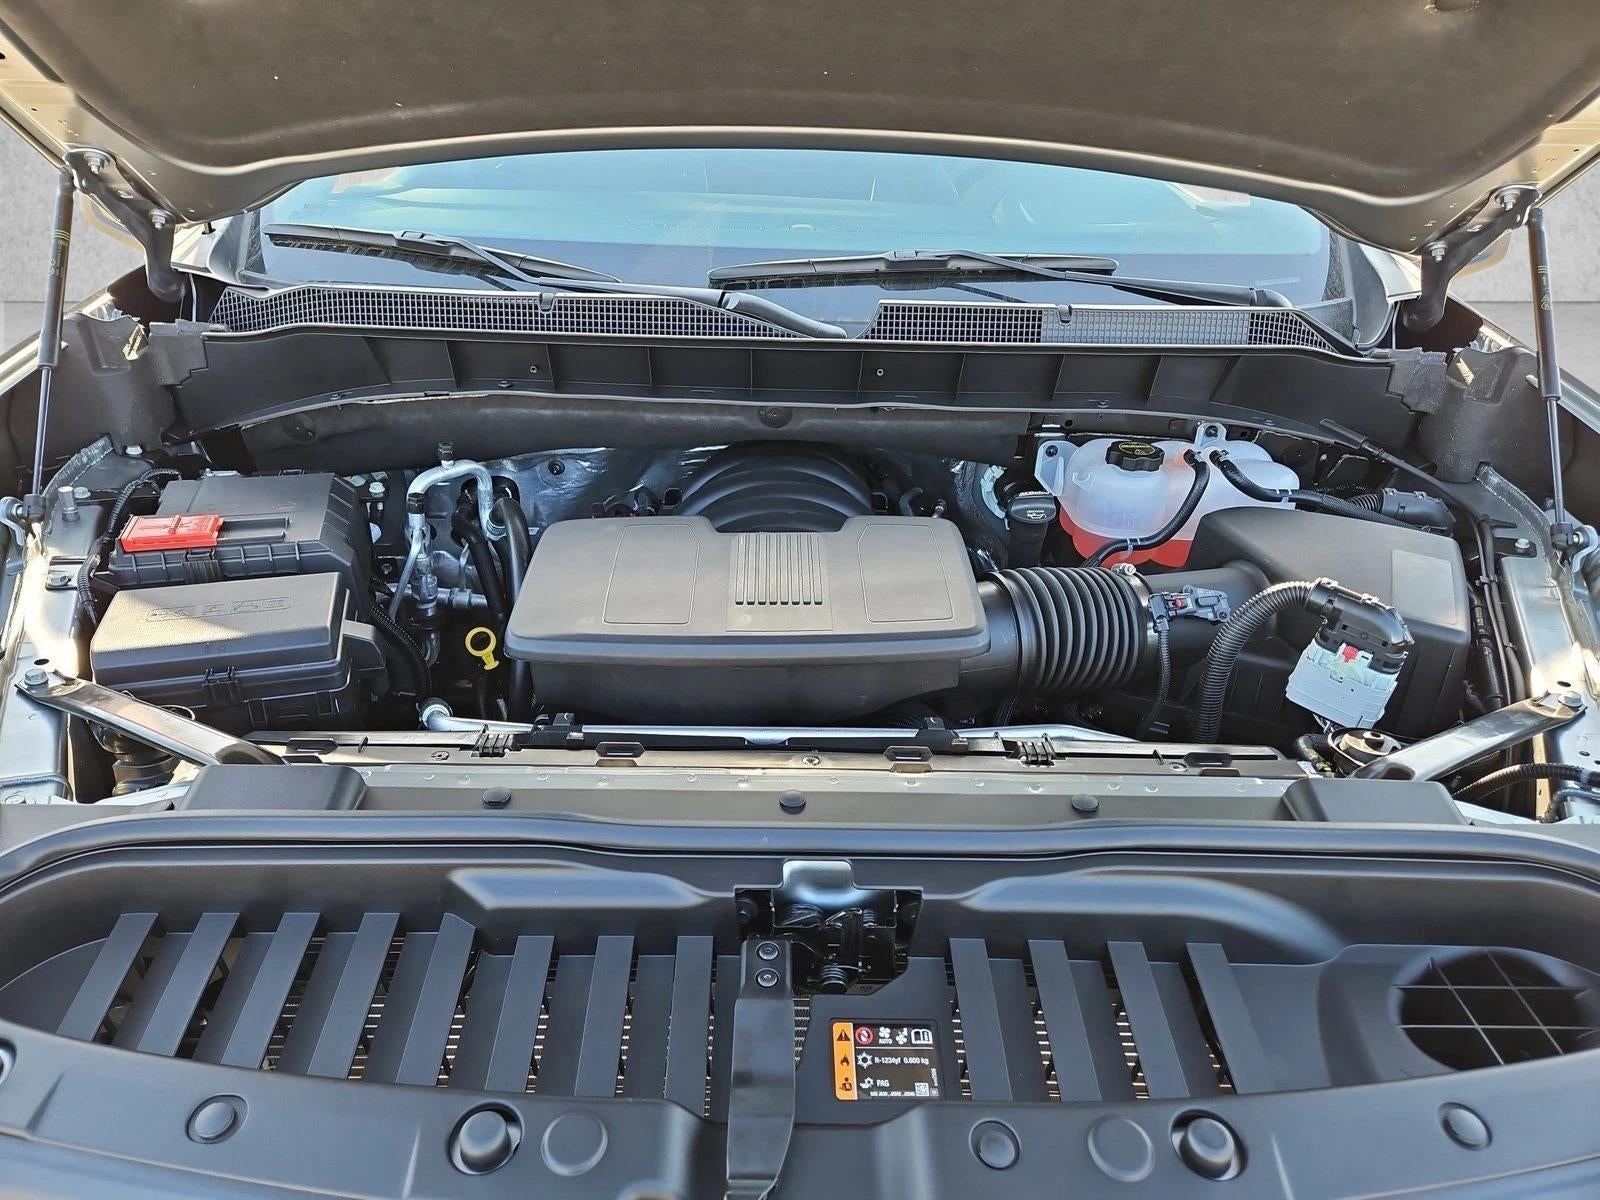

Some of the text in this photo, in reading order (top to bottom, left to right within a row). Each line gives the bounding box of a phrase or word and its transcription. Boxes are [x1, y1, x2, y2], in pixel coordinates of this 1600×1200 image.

[874, 1057, 901, 1065] R-1234yf
[921, 1057, 929, 1065] kg
[876, 1079, 890, 1087] PAG
